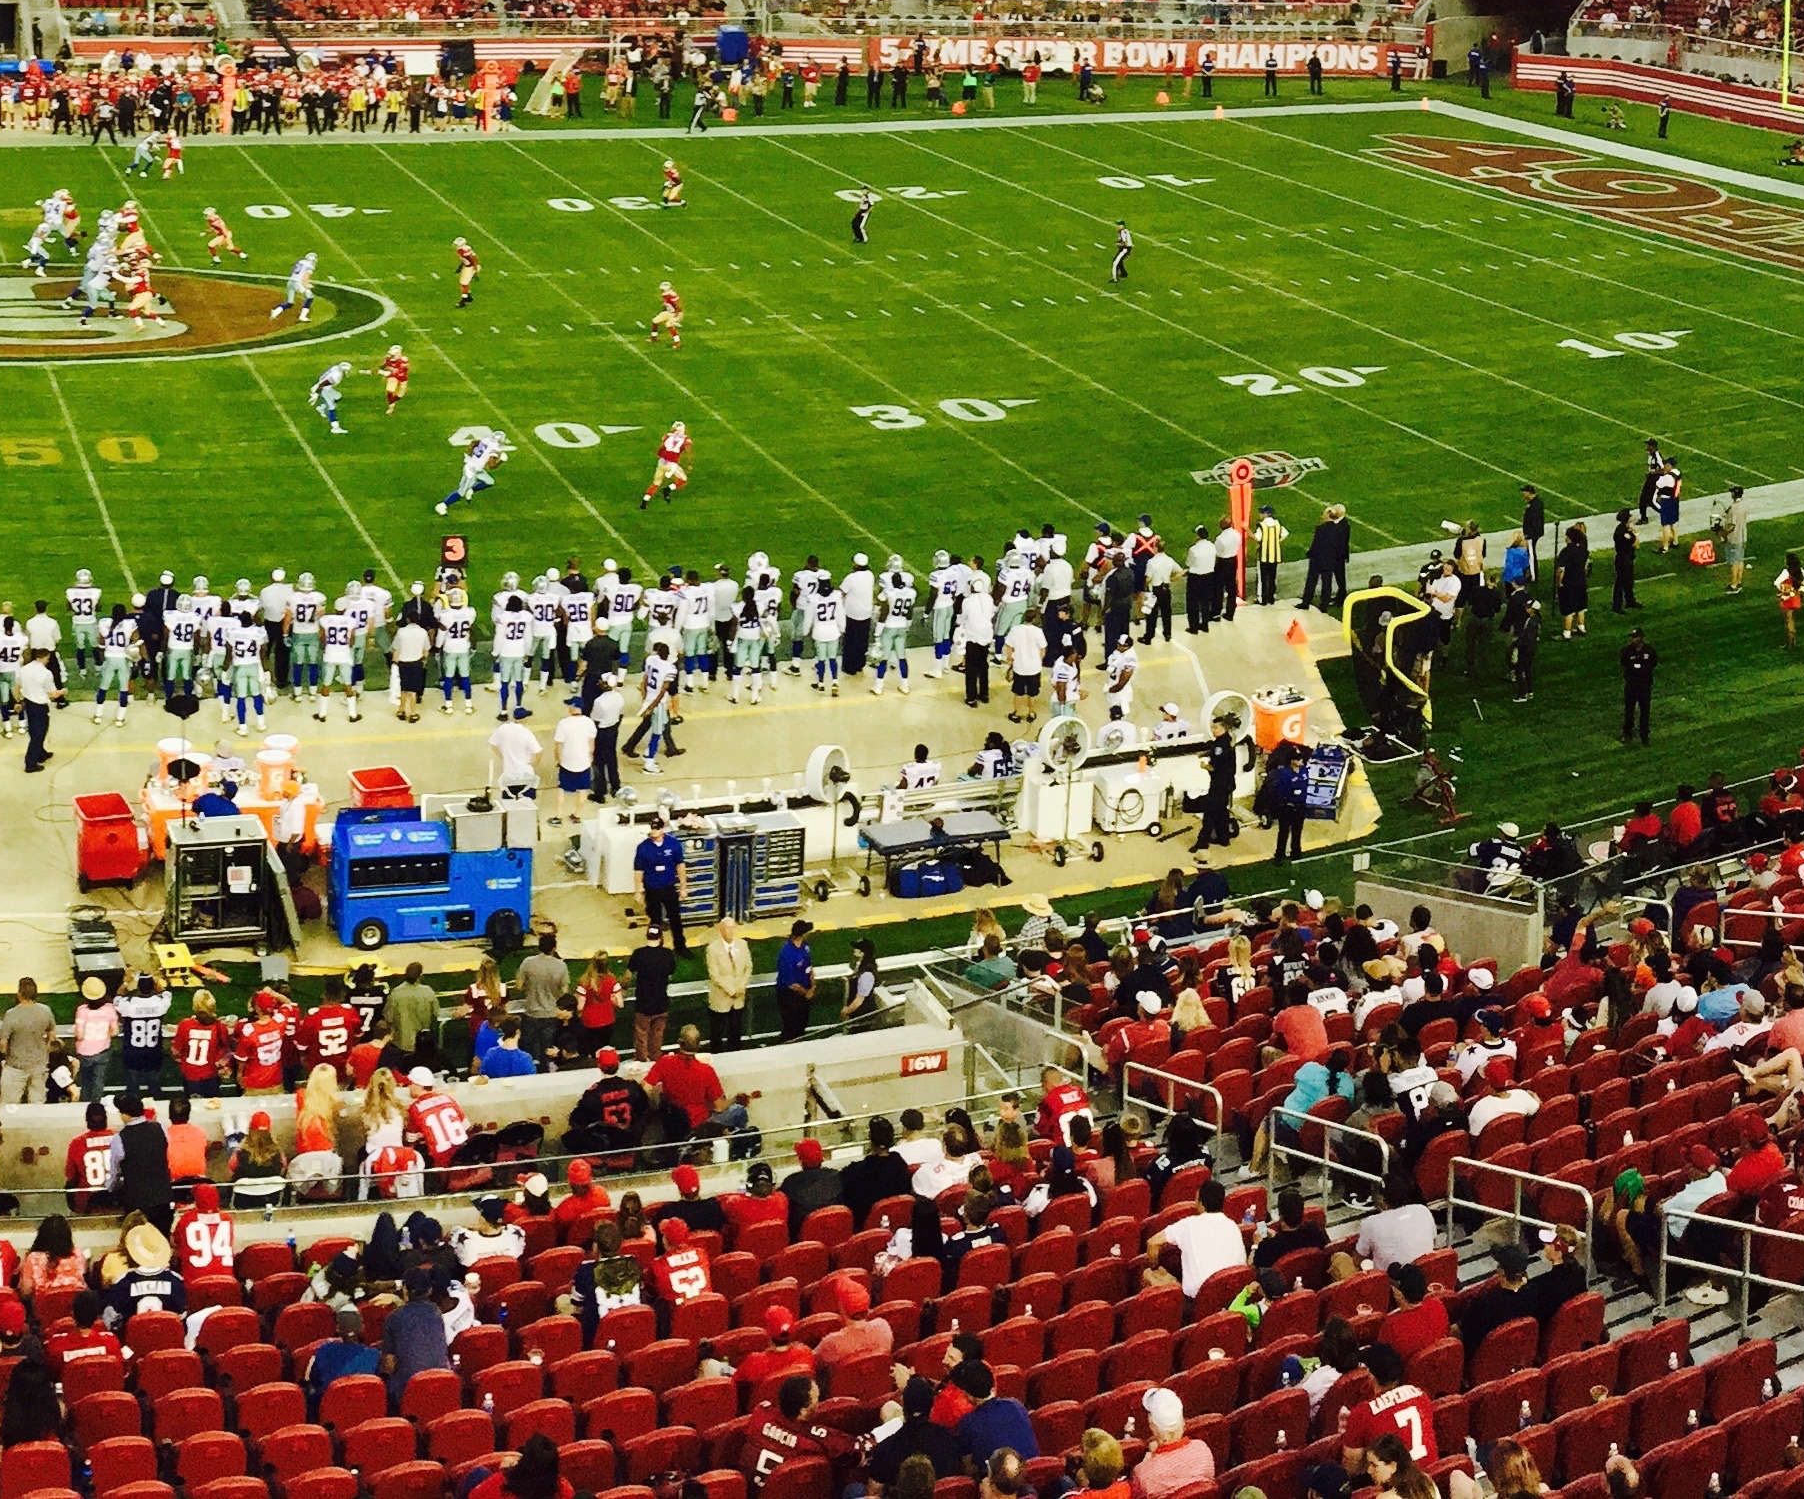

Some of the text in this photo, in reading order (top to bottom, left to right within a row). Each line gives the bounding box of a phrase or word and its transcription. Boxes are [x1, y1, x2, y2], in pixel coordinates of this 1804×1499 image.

[879, 38, 1378, 72] 5-IME SUR BOWL CHAMPIONS
[1555, 330, 1676, 360] 10
[1219, 366, 1362, 397] 20
[850, 397, 1010, 430] 30
[0, 435, 160, 467] 50
[444, 537, 466, 562] 3
[72, 597, 93, 616] 33
[295, 604, 317, 623] 87
[535, 603, 555, 623] 30
[566, 603, 588, 622] 26
[614, 594, 635, 613] 90
[694, 597, 710, 615] 71
[818, 601, 837, 621] 27
[173, 623, 193, 642] 48
[326, 625, 349, 646] 83
[507, 621, 527, 641] 39
[233, 638, 257, 658] 54
[1282, 713, 1302, 739] G
[359, 1008, 375, 1032] 7
[131, 1019, 159, 1048] 88
[318, 1027, 349, 1057] 52
[187, 1039, 210, 1065] 11
[425, 1107, 469, 1142] 16
[186, 1221, 234, 1268] 94
[1394, 1405, 1428, 1461] 7
